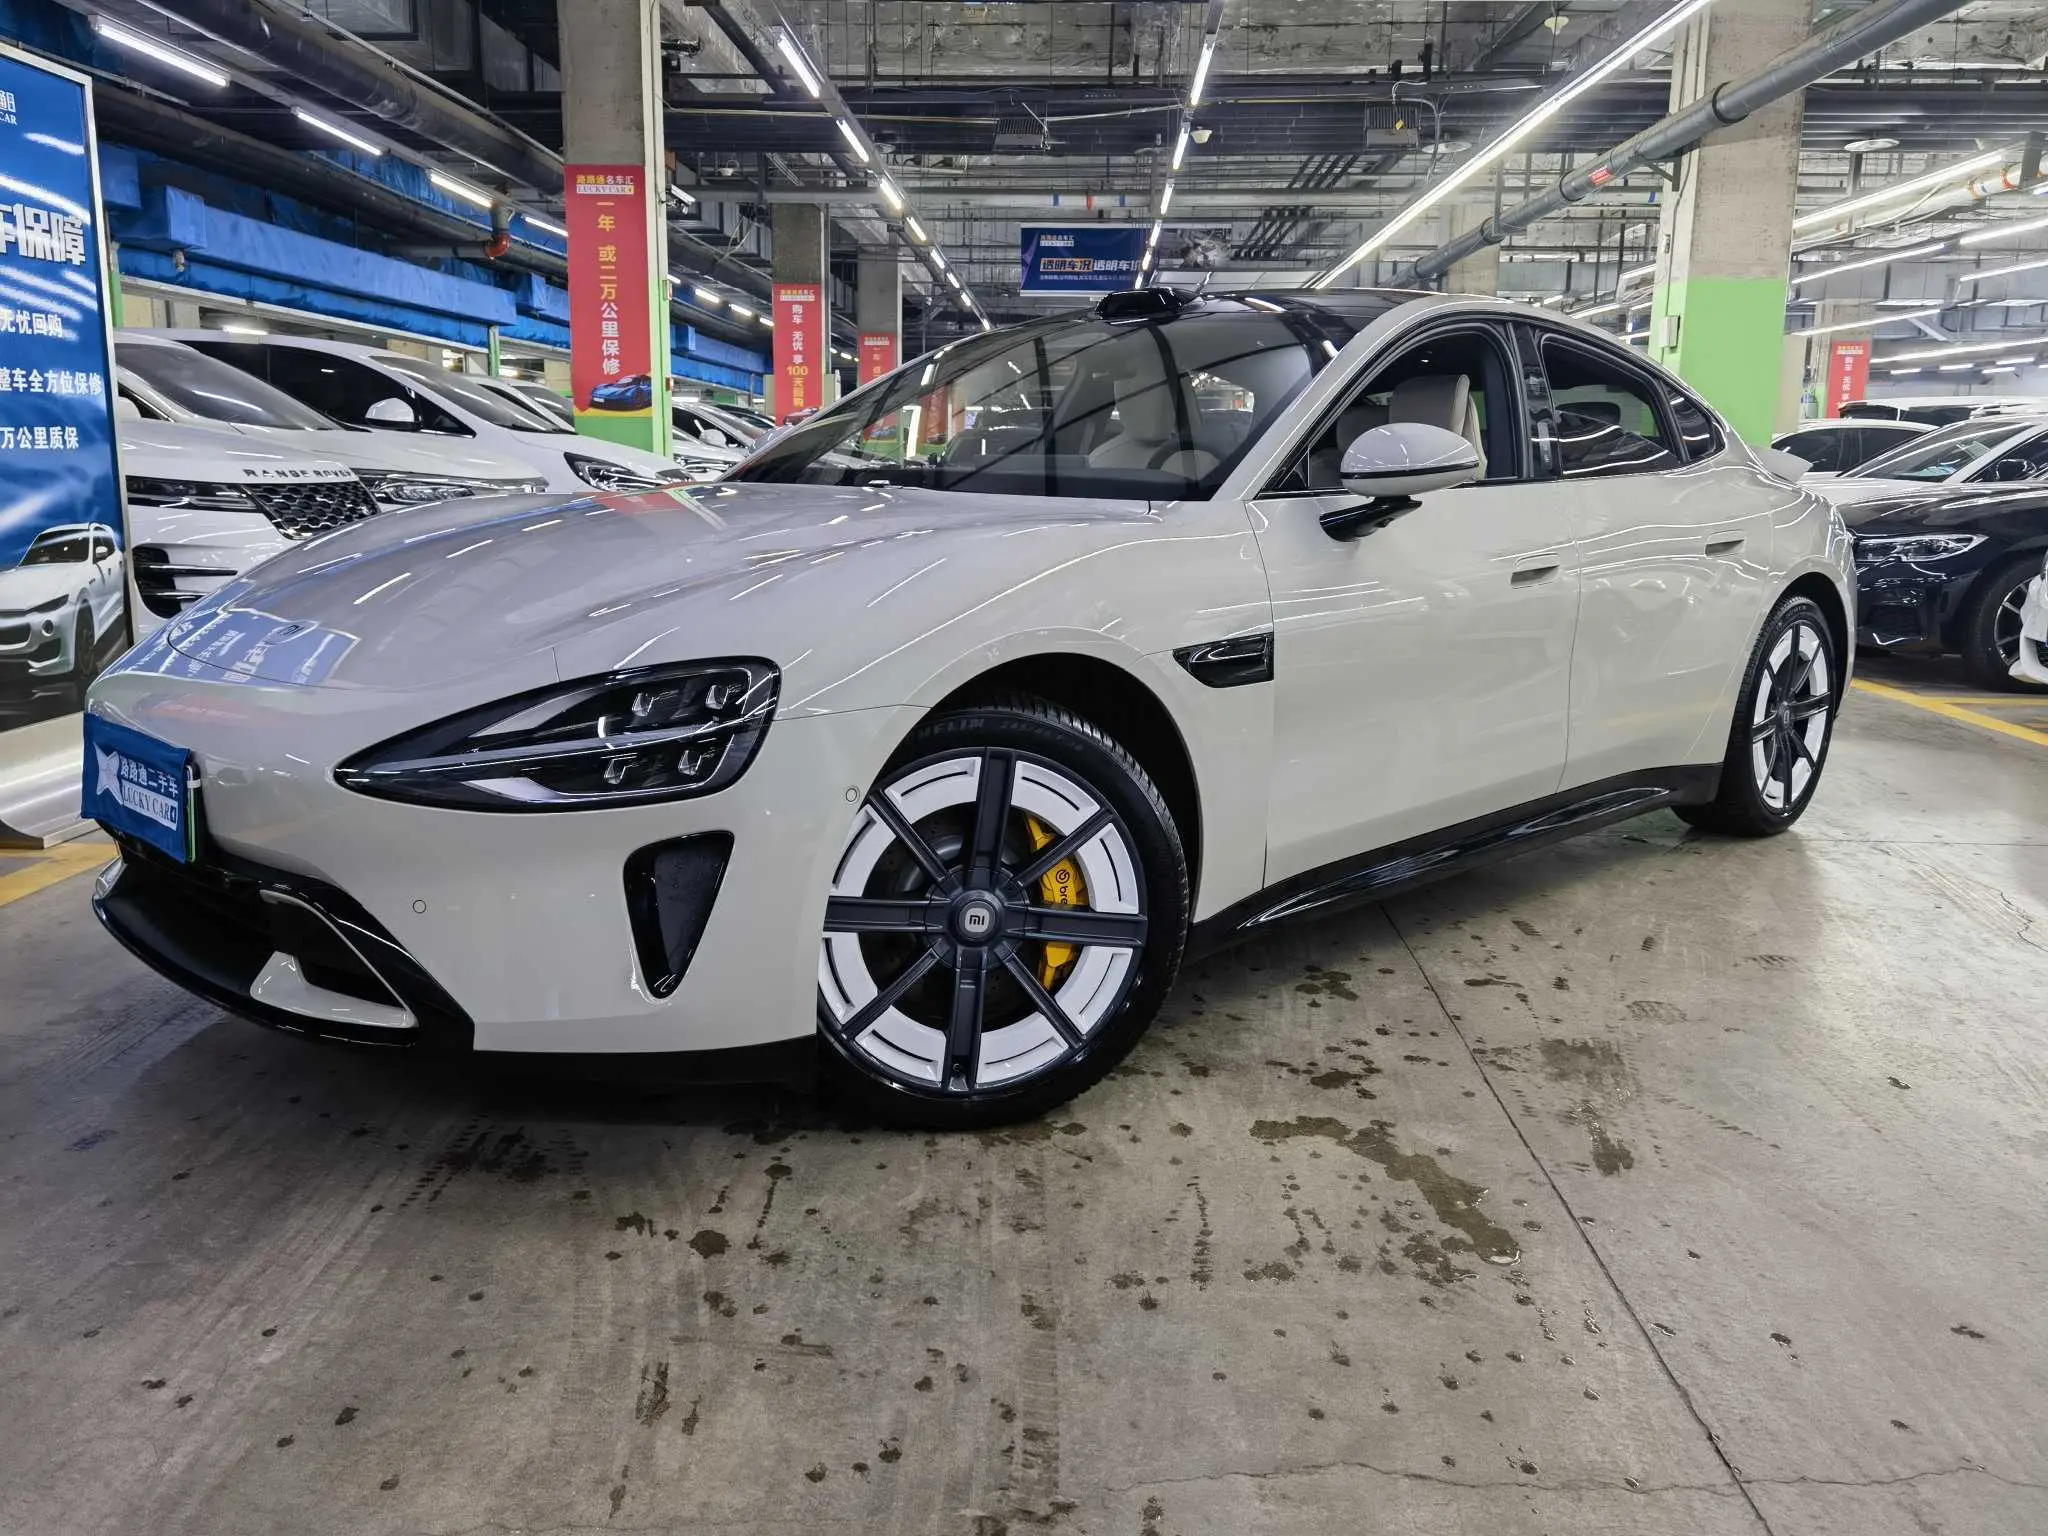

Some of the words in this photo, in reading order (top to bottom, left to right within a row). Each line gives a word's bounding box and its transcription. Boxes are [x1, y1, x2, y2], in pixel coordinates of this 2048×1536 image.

[0, 308, 62, 337] 无忧回购
[0, 367, 103, 395] 整车全方位保修
[0, 426, 79, 449] 万公里质保
[1059, 885, 1068, 905] bre
